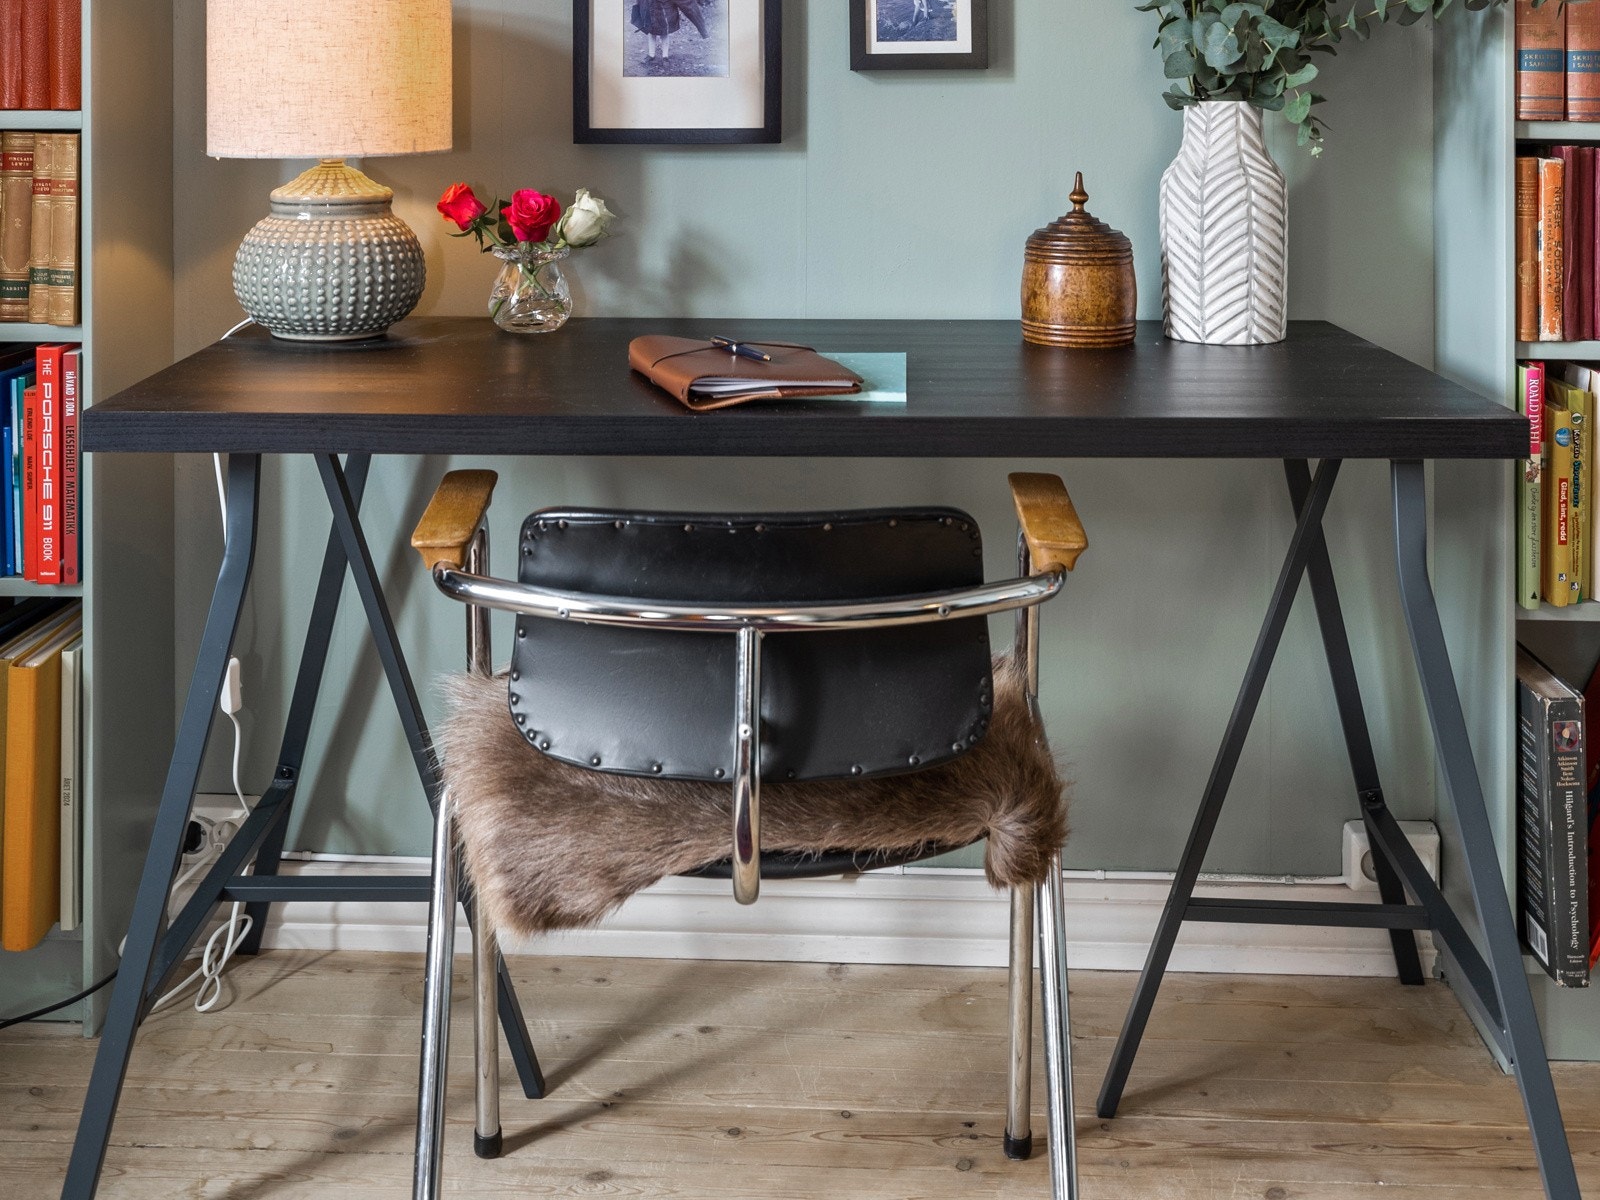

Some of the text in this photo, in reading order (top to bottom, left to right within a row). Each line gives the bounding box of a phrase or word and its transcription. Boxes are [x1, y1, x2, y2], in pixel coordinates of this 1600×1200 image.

[1554, 186, 1562, 312] NORSK SOLDATBOK
[42, 358, 52, 375] THE
[65, 371, 74, 395] HÅVARD
[1529, 378, 1540, 412] ROALD
[66, 398, 74, 416] TJORA
[42, 382, 52, 500] PORSCHE
[66, 425, 74, 472] LEKSEHJELP
[42, 505, 52, 530] 911
[66, 481, 75, 535] MATEMATIKK
[43, 537, 52, 561] BOOK
[64, 778, 72, 791] ÅRET
[1565, 790, 1579, 950] Hilgard's Introduction to Psychology
